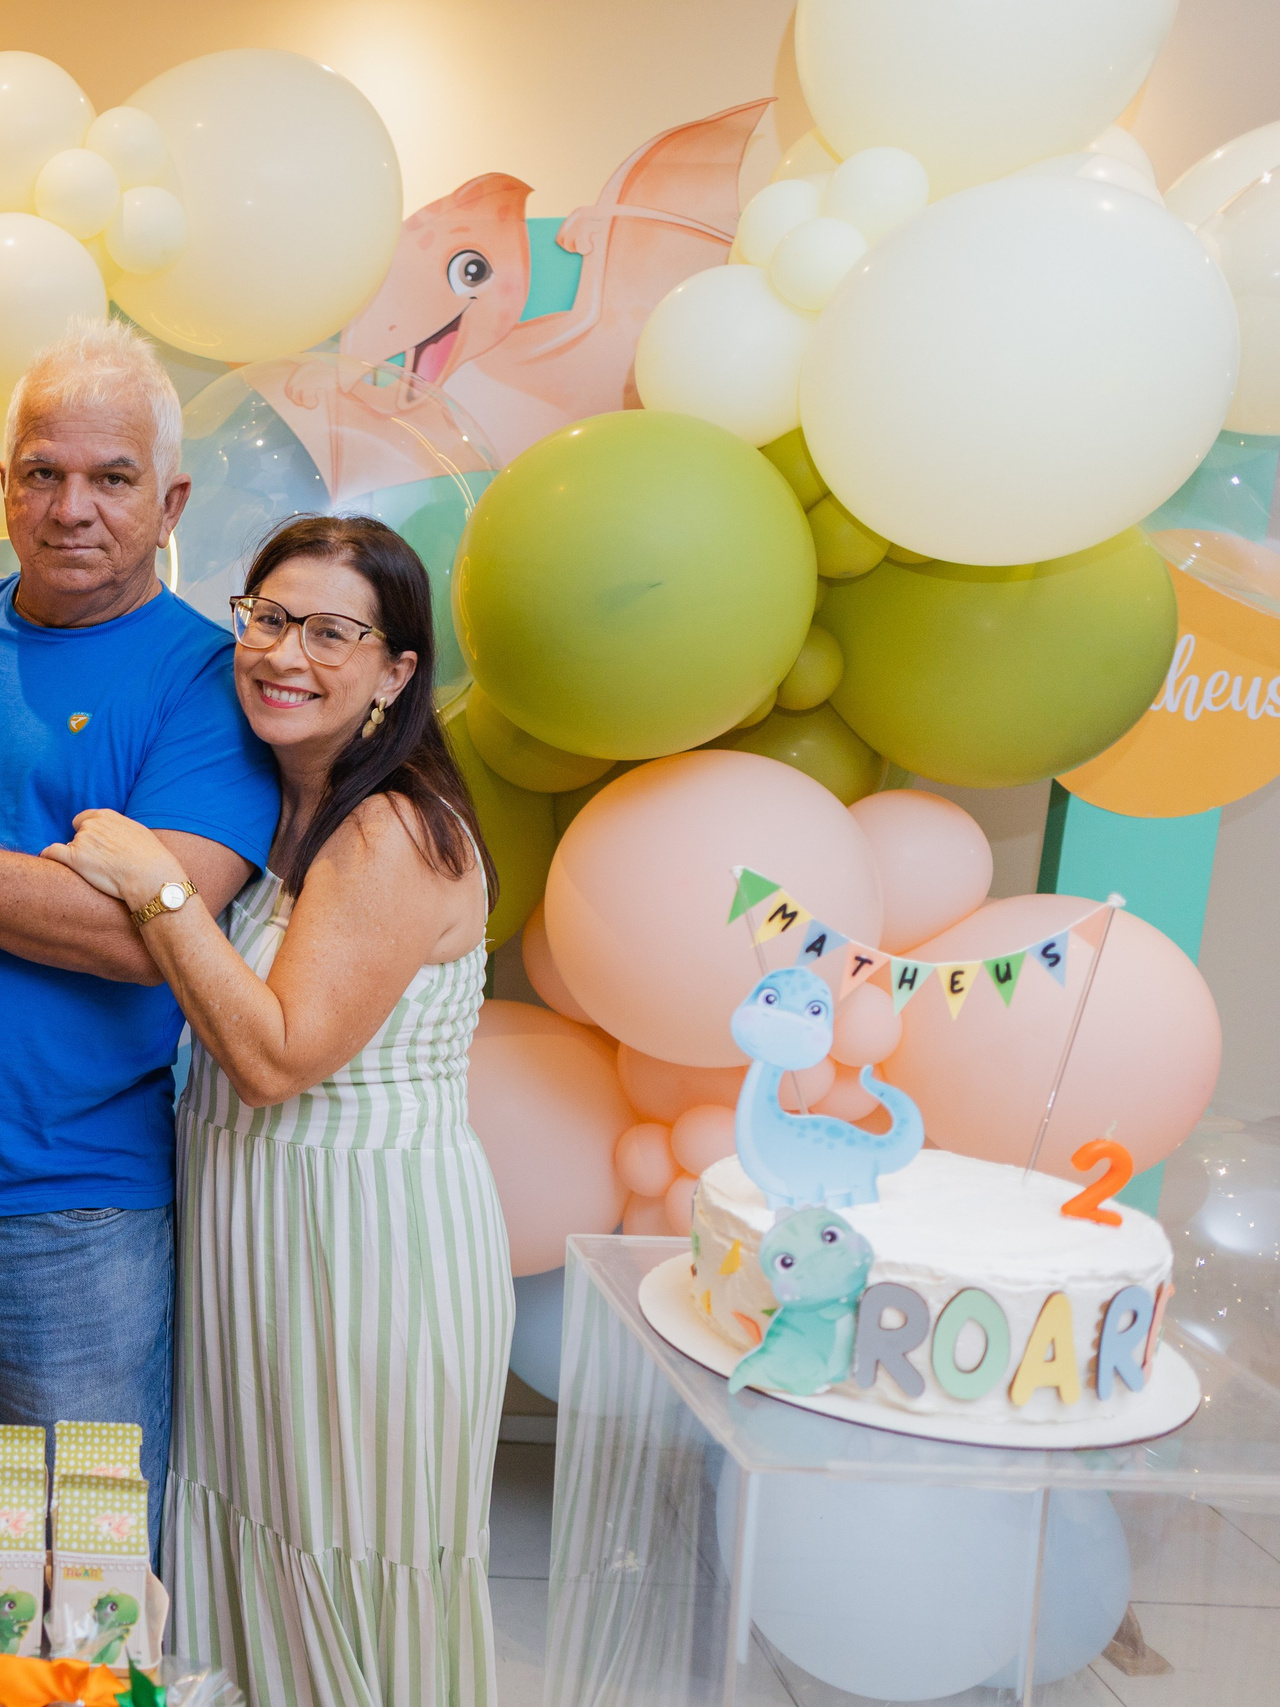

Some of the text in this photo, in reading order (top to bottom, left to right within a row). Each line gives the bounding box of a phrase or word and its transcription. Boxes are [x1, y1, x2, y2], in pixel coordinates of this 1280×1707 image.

[1150, 633, 1280, 721] heus
[768, 902, 1061, 995] MATHEUS
[1061, 1139, 1133, 1228] 2
